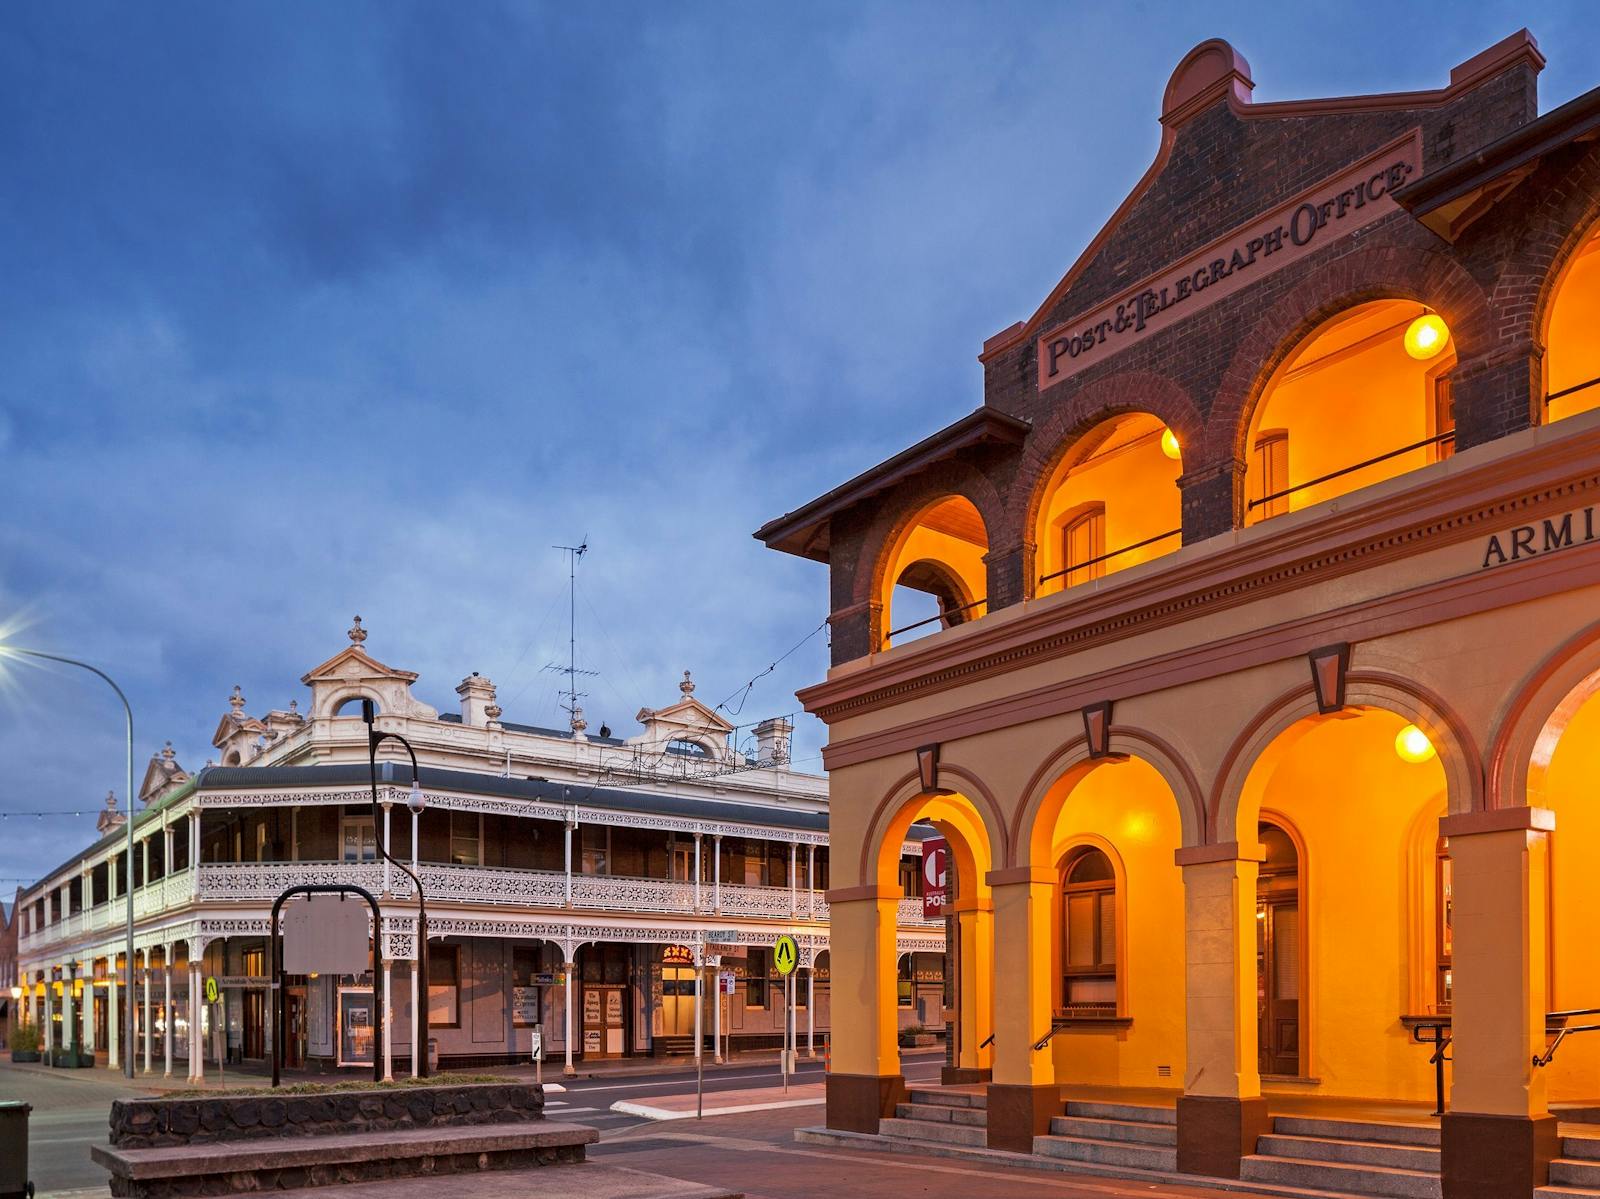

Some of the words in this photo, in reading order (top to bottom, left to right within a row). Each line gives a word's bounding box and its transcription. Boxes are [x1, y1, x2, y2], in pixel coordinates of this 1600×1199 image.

[1048, 320, 1107, 378] POST
[1114, 303, 1132, 333] &
[1126, 225, 1284, 333] TELEGRAPH
[1290, 160, 1408, 247] OFFICE
[1482, 507, 1595, 568] ARMI
[926, 895, 947, 907] POS
